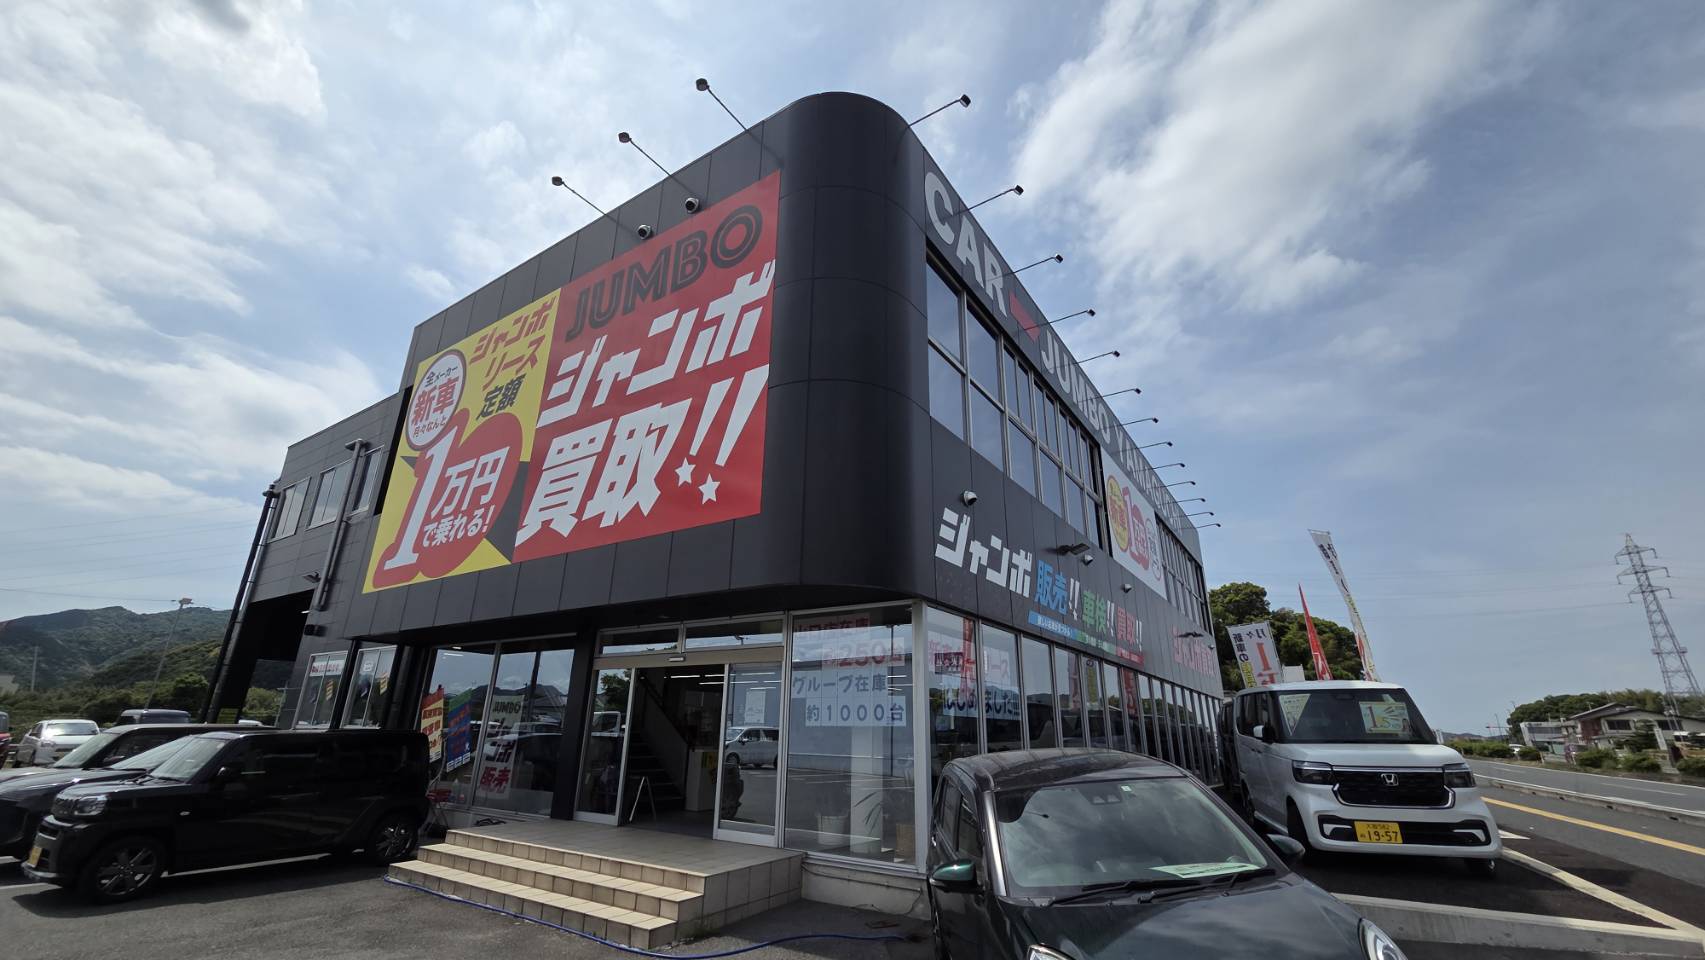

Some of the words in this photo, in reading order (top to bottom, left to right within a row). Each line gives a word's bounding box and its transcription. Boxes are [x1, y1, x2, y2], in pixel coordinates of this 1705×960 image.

[565, 204, 763, 343] JUMBO
[469, 295, 557, 364] ジャンボ
[924, 172, 1008, 317] CAR
[1040, 330, 1111, 444] JUMBO
[482, 335, 546, 391] リース
[536, 259, 776, 428] ジャンボ
[411, 376, 460, 426] 新車
[424, 366, 459, 388] 全メーカー
[476, 373, 527, 420] 定額
[935, 507, 1033, 598] ジャンボ
[493, 701, 521, 714] JUMBO
